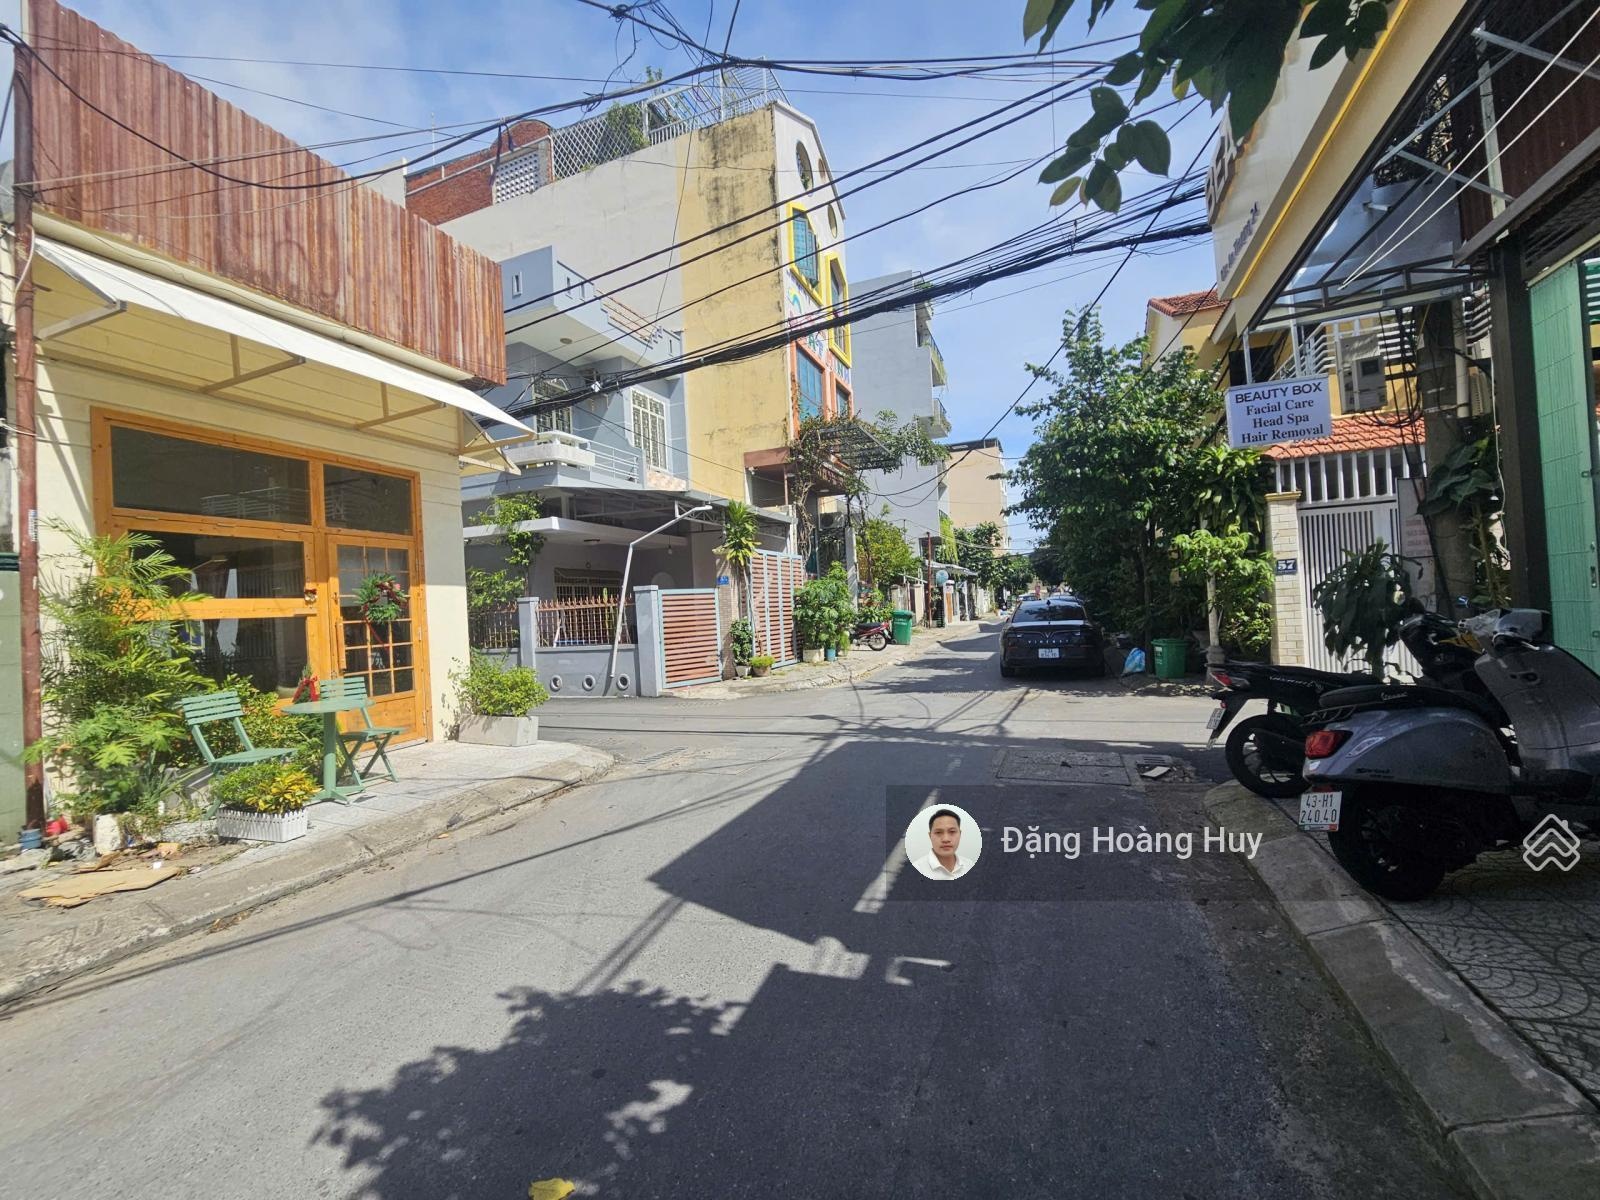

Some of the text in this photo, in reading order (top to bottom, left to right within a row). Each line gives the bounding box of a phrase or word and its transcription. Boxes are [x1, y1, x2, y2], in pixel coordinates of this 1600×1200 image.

[1235, 382, 1322, 404] BEAUTY BOX
[1246, 399, 1314, 416] Facial Care
[1253, 413, 1309, 428] Head Spa
[1241, 424, 1324, 443] Hair Removal
[1277, 560, 1295, 570] 57
[1306, 793, 1333, 808] 43-H1
[1300, 808, 1337, 823] 240.40
